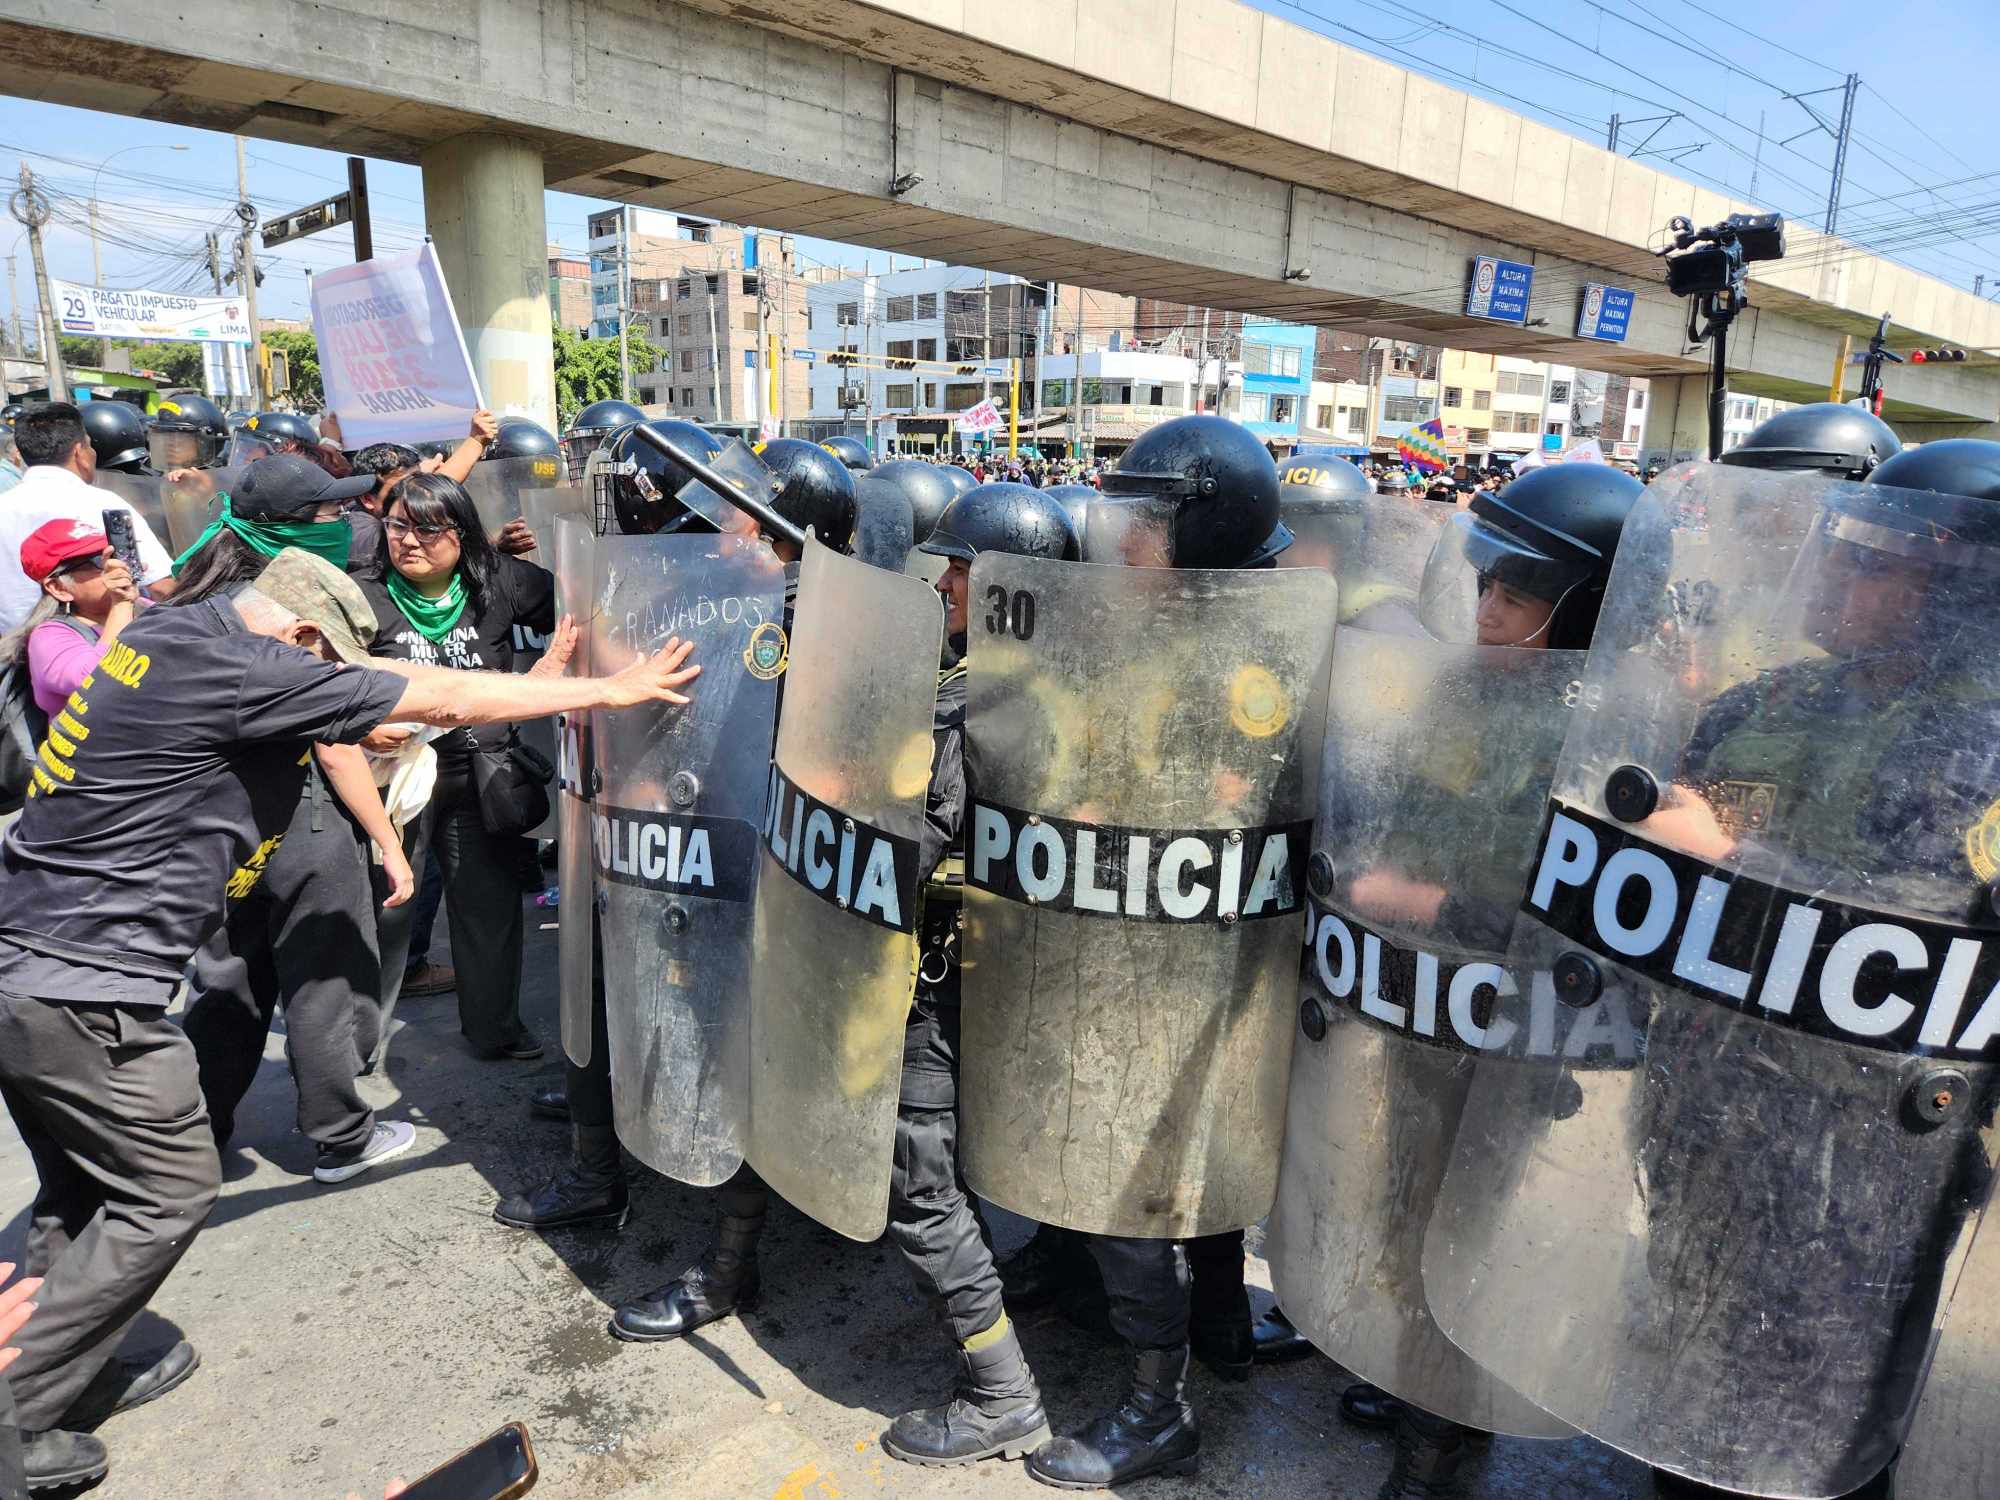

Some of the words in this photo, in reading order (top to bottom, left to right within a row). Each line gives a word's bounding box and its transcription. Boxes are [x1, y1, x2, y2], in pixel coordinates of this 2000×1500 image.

[1501, 269, 1526, 283] ALTURA
[63, 297, 86, 319] 29
[93, 290, 122, 306] PAGA
[123, 293, 140, 308] TU
[140, 295, 198, 312] IMPUESTO
[1493, 301, 1521, 314] PERMITIDA
[1607, 295, 1629, 306] ALTURA
[96, 307, 158, 323] VEHICULAR
[220, 325, 249, 335] LIMA
[1599, 322, 1624, 334] PERMITIDA
[533, 462, 556, 476] USE
[1281, 466, 1332, 488] ICIA
[985, 584, 1036, 641] 30
[410, 641, 467, 659] MUER
[974, 803, 1296, 920] POLICIA
[1303, 901, 1638, 1058] OLICIA
